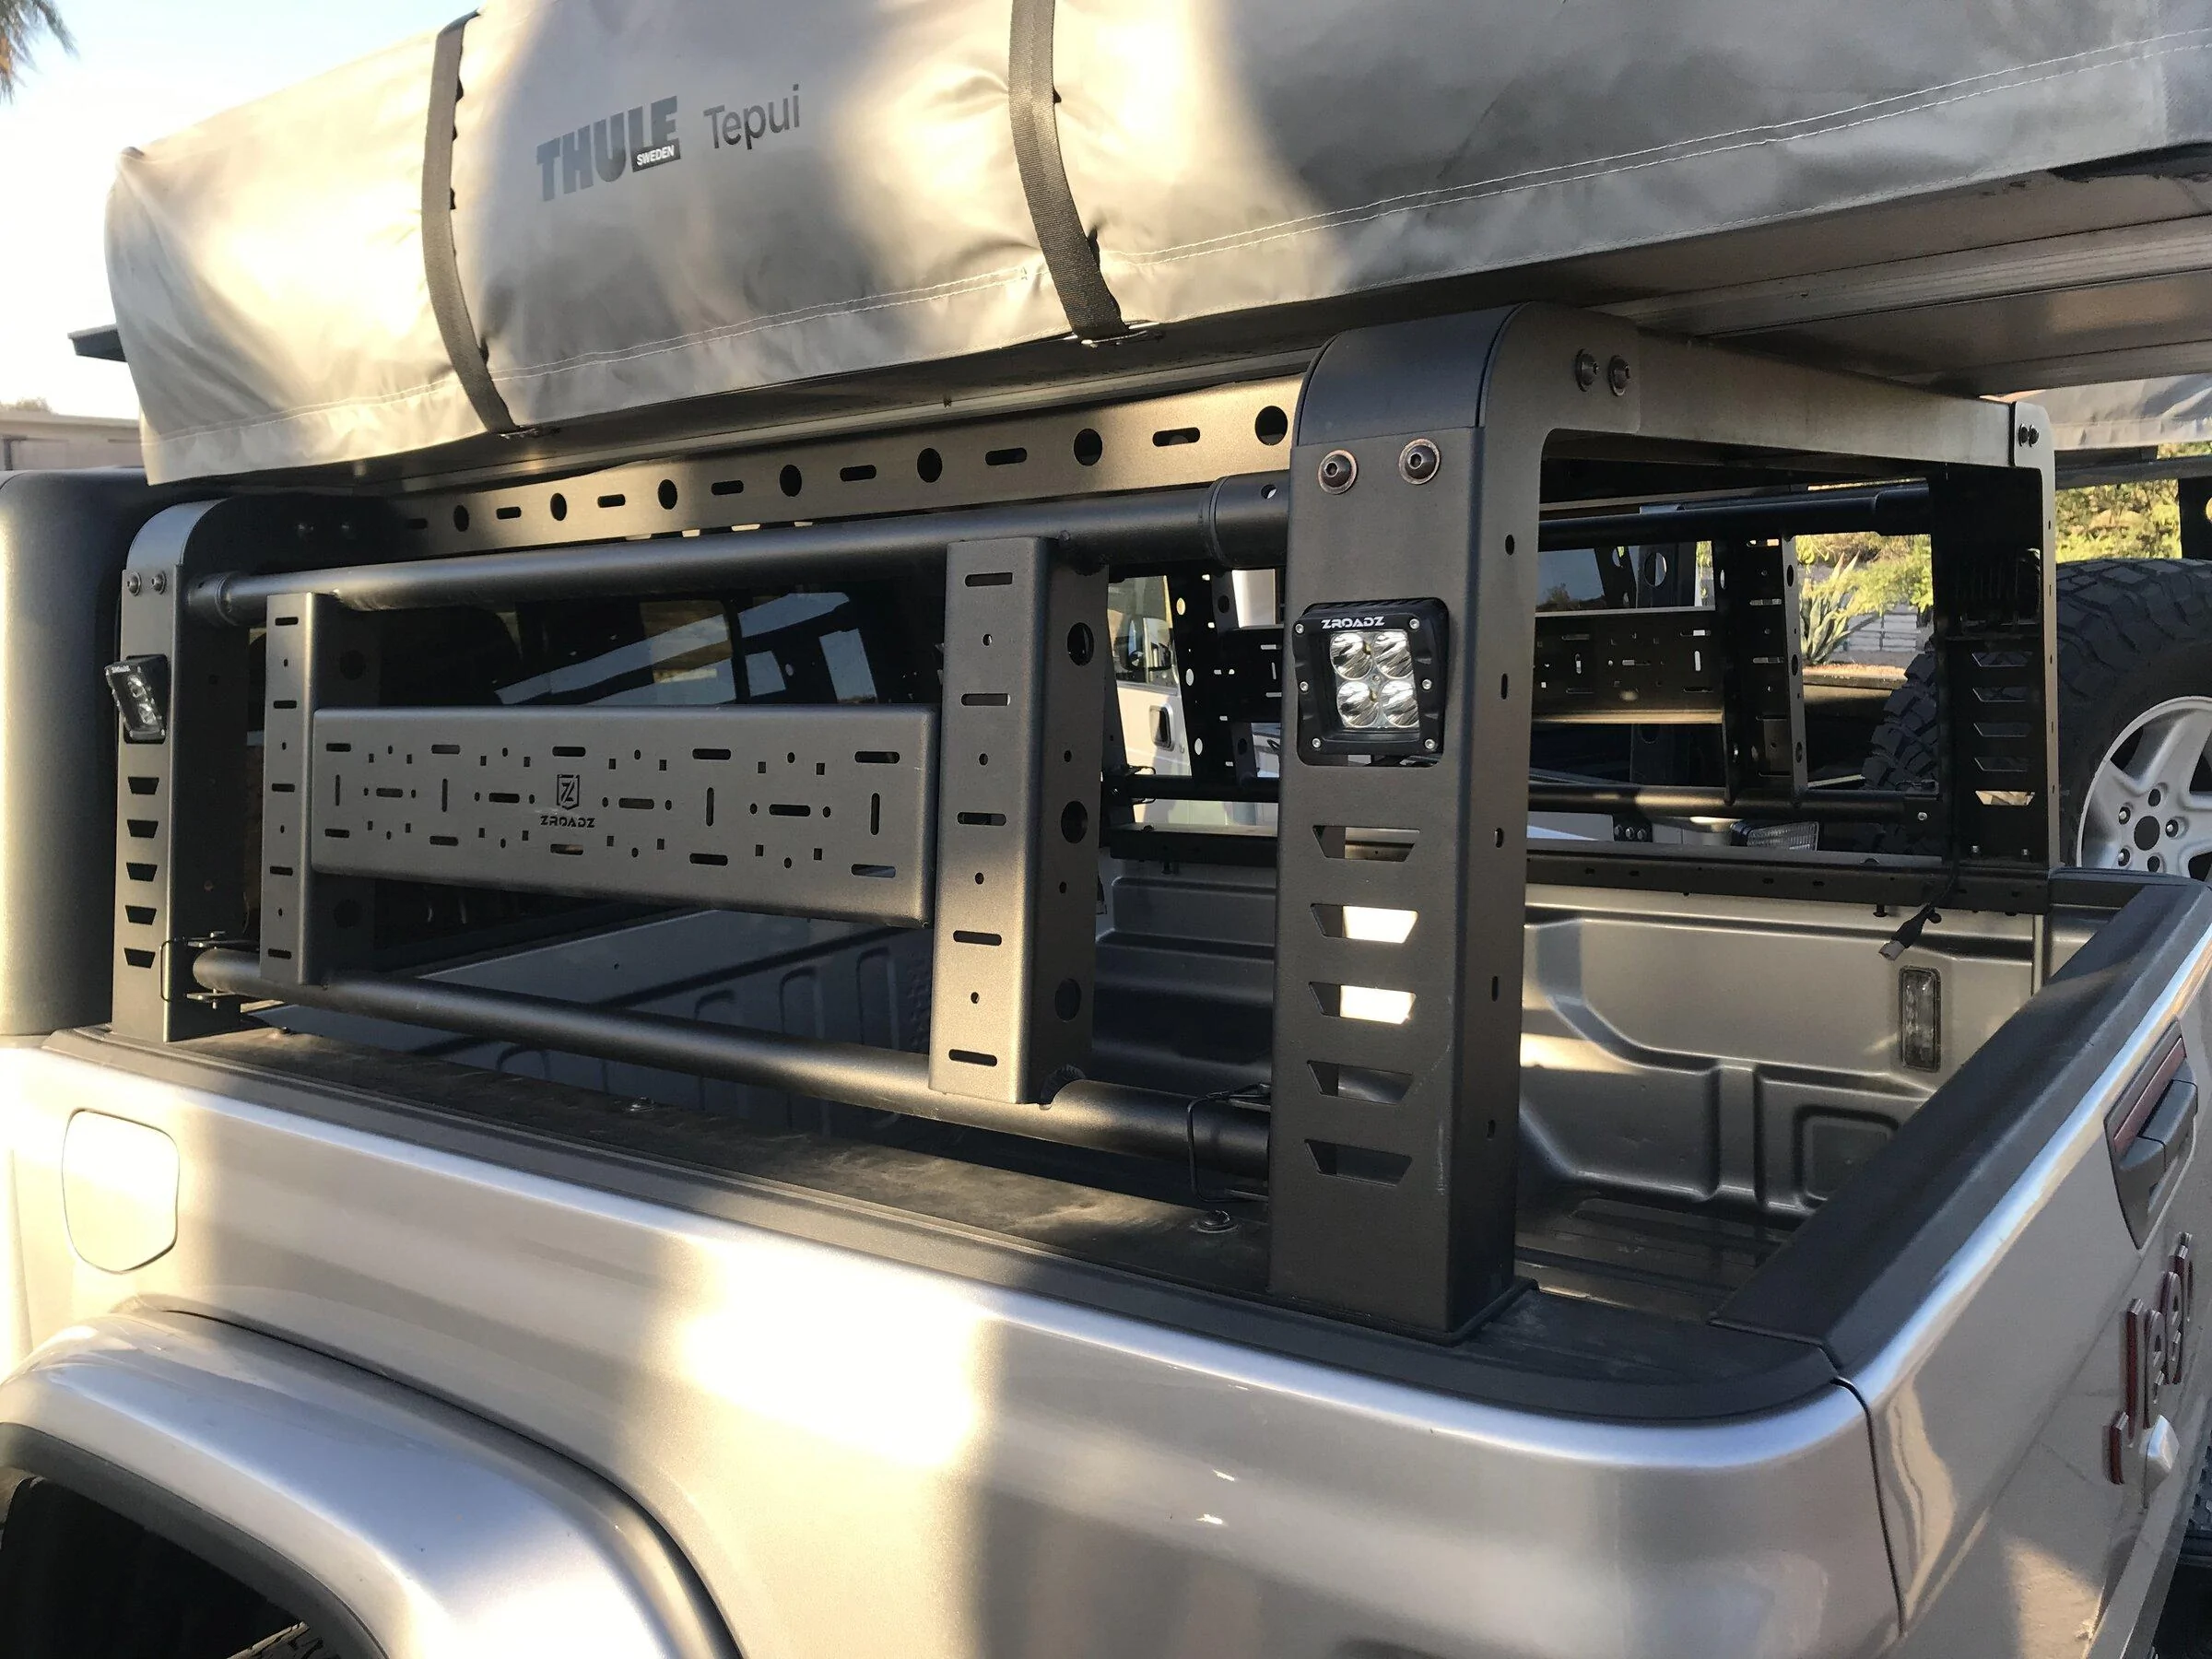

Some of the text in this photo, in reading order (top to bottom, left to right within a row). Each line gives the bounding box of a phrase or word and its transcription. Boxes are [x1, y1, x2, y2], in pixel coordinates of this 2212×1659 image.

[536, 84, 800, 202] THULE Tepui
[636, 145, 676, 167] SWEDEN
[1321, 616, 1385, 629] ZROADZ
[540, 815, 595, 829] ZROADZ
